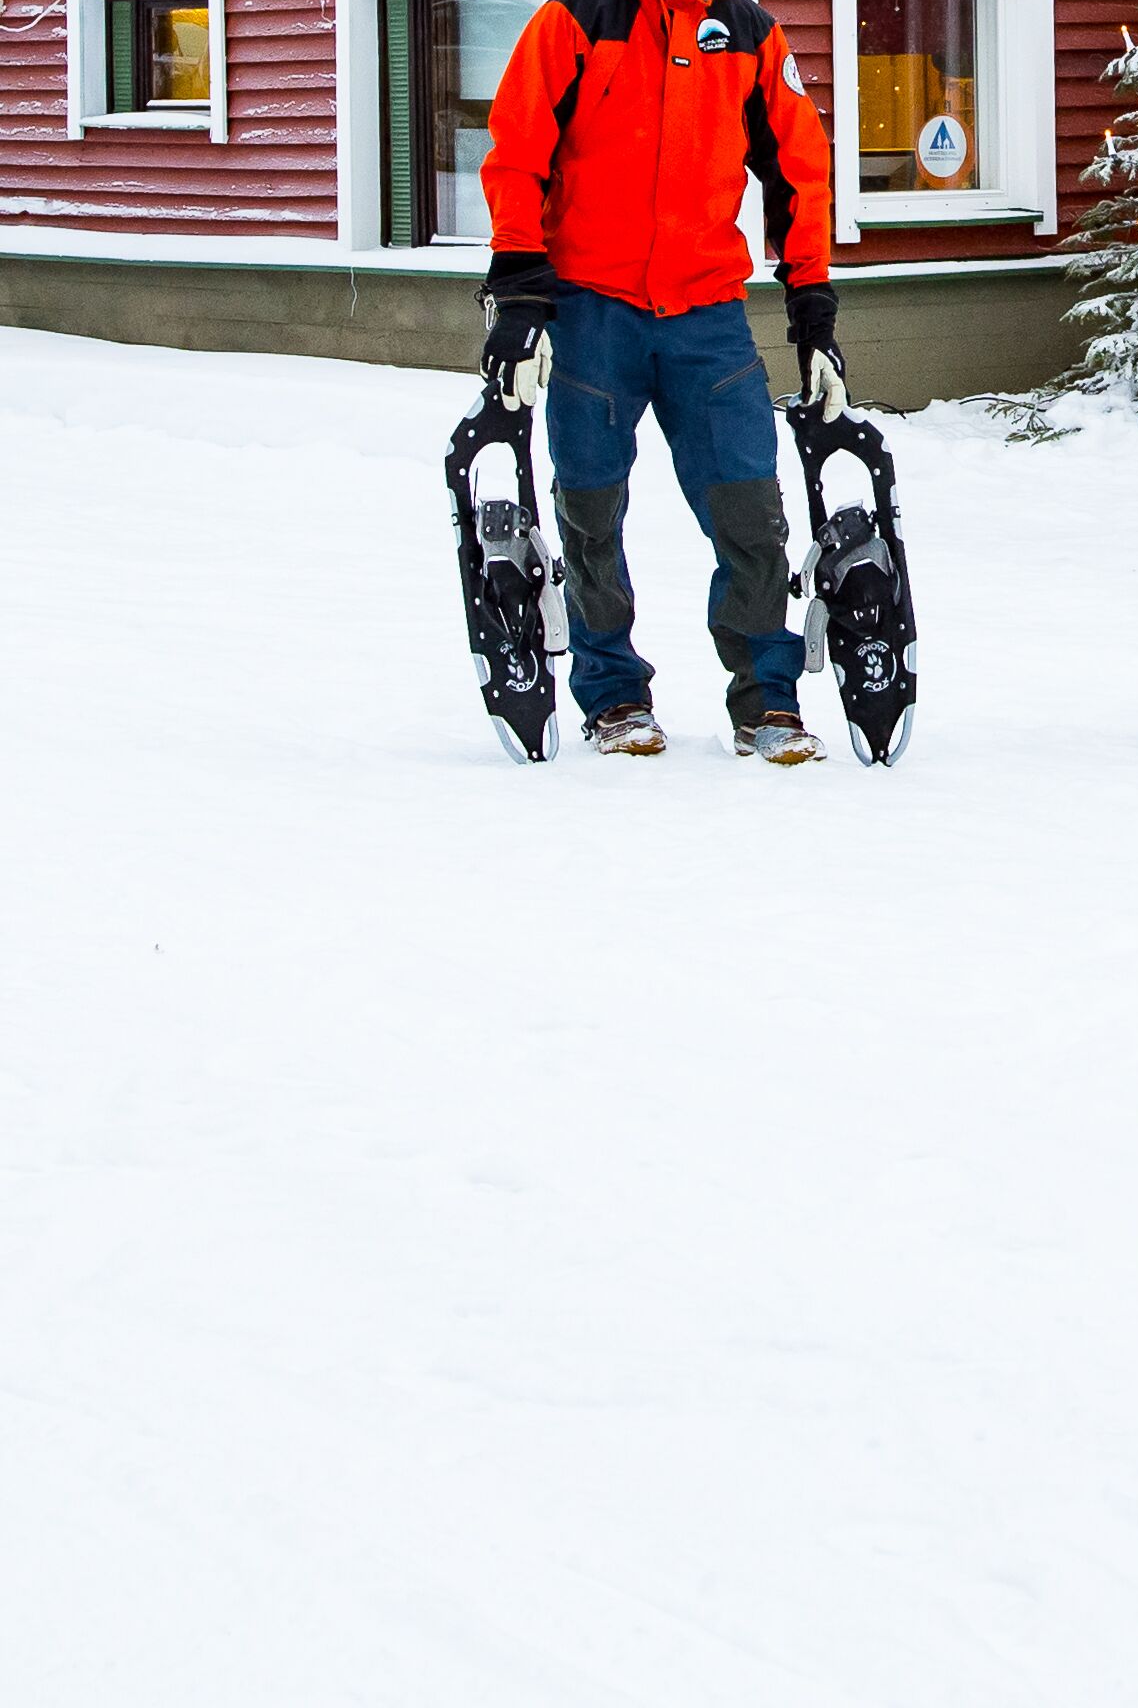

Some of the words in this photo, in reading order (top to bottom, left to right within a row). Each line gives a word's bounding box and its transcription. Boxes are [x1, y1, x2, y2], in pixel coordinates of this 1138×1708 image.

[857, 642, 888, 658] SNOW
[506, 678, 533, 692] FOX
[862, 676, 890, 692] FOX
